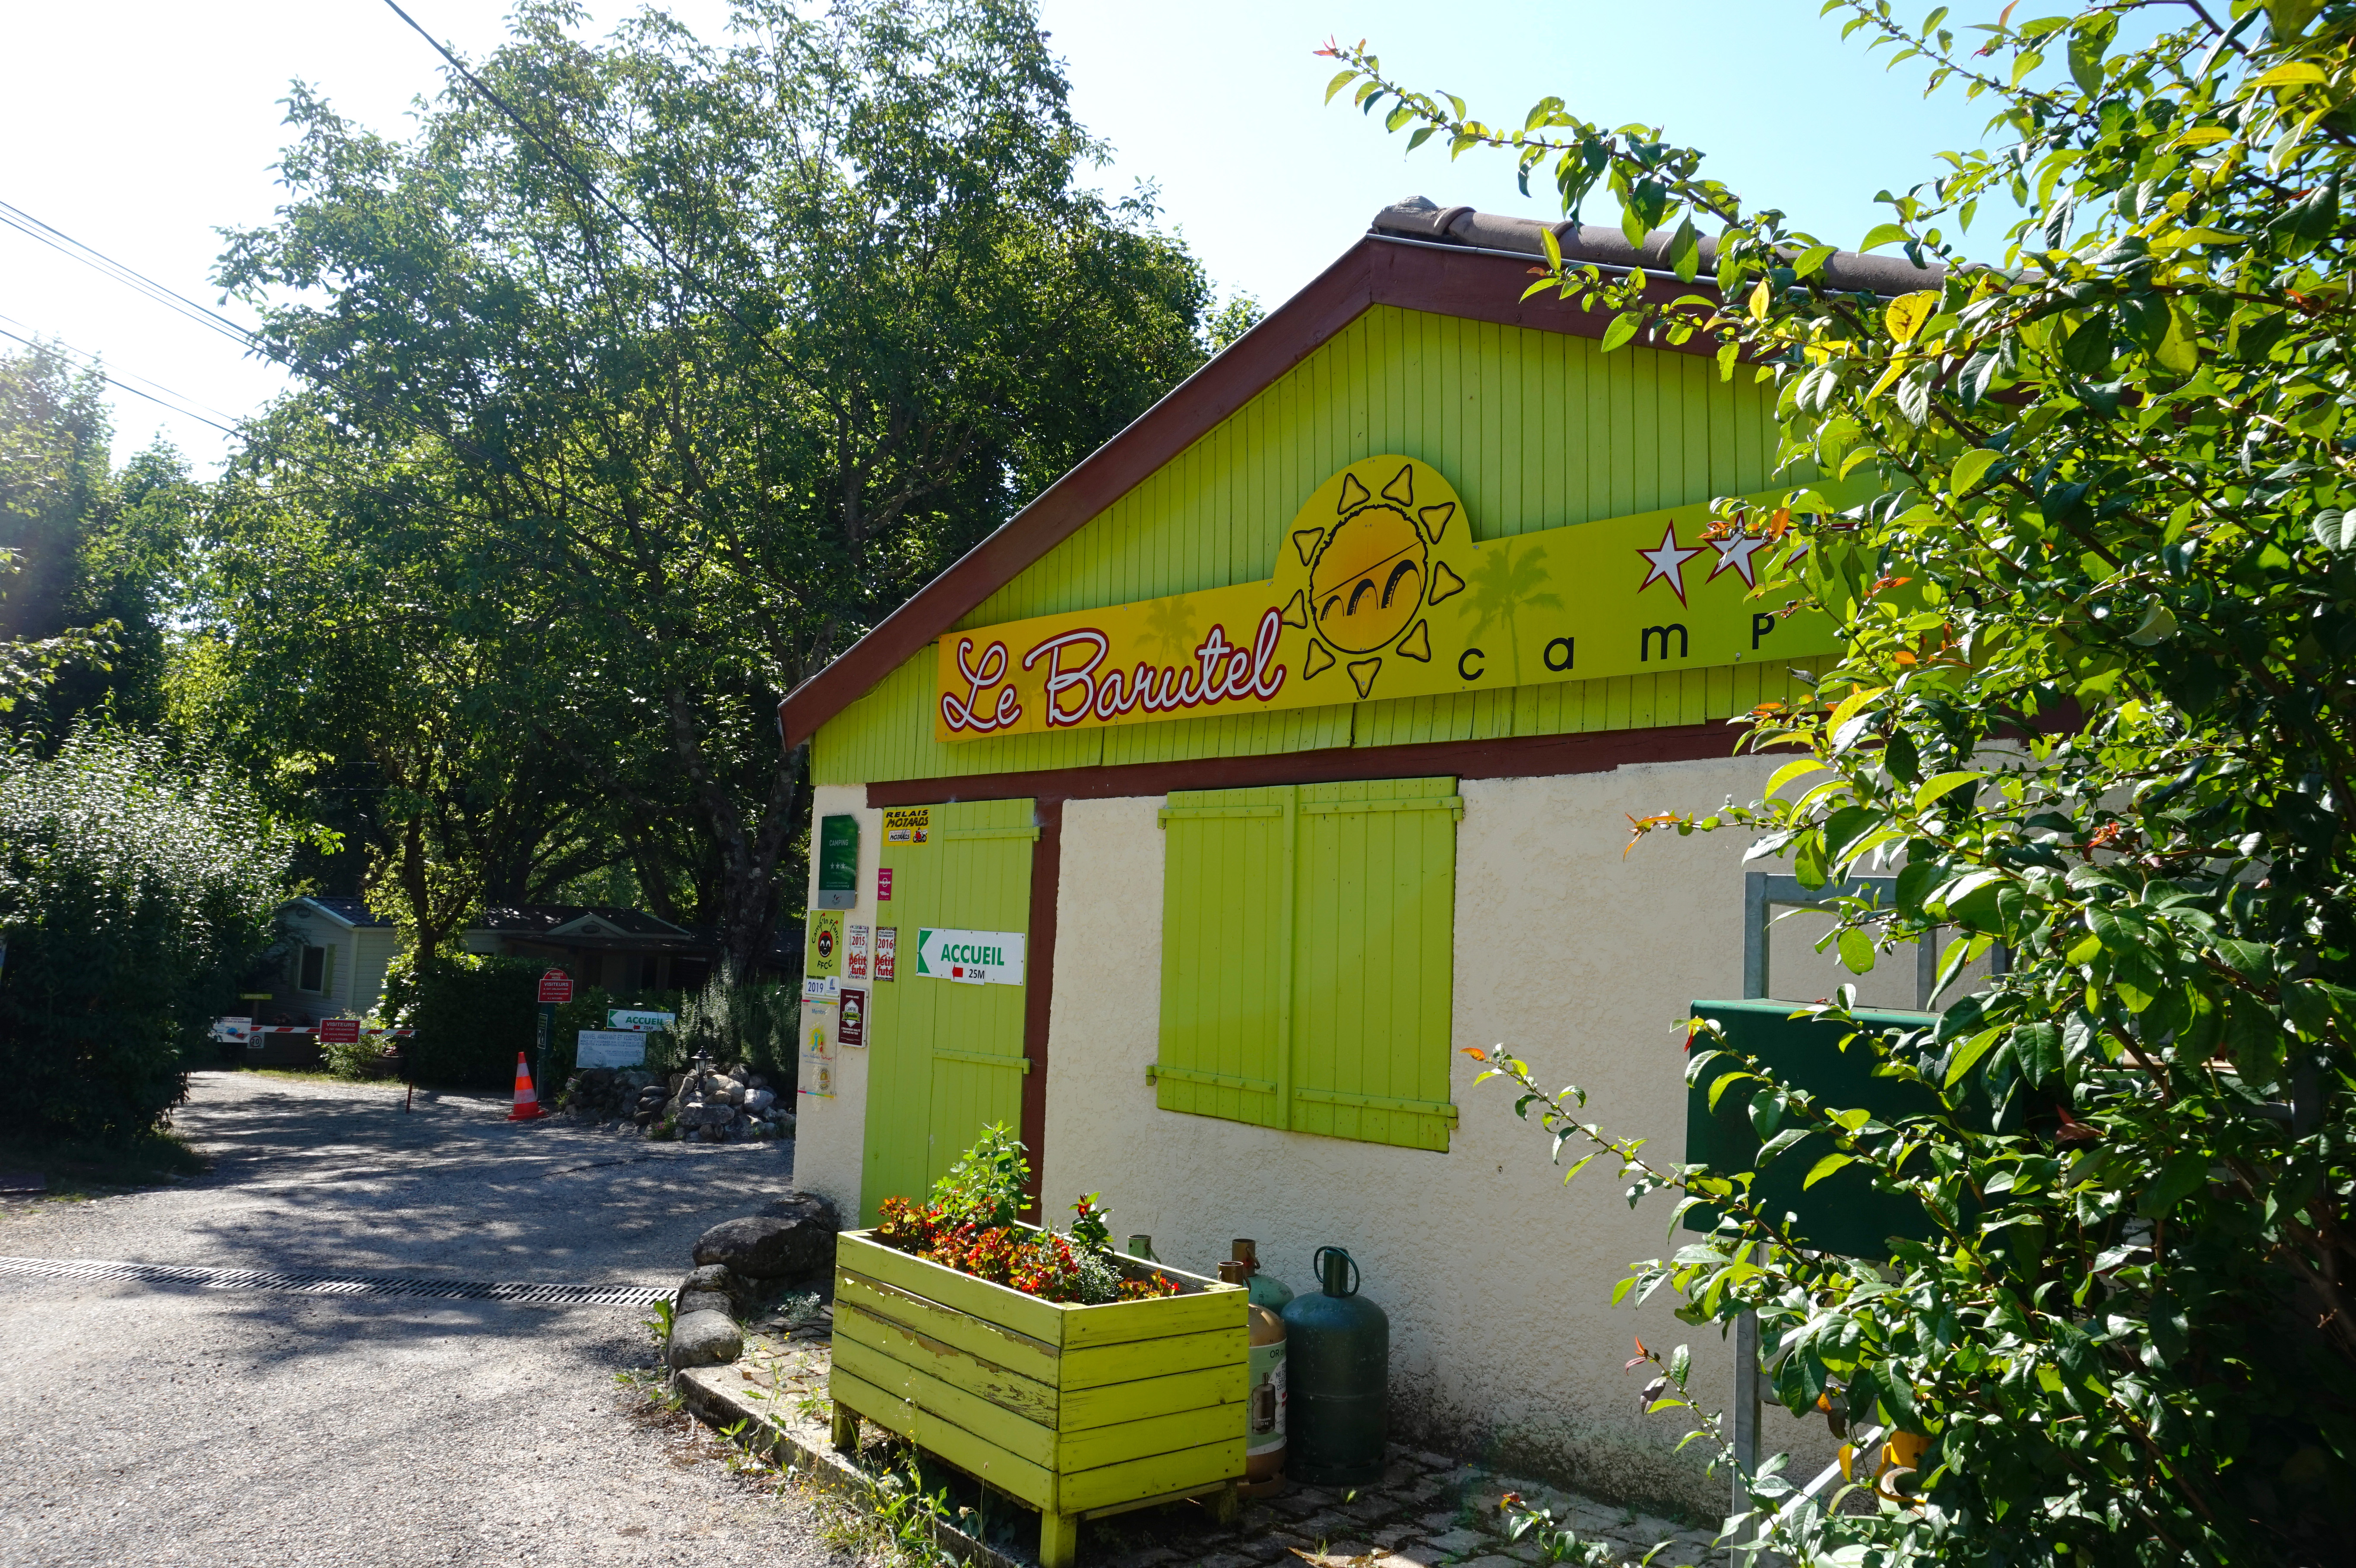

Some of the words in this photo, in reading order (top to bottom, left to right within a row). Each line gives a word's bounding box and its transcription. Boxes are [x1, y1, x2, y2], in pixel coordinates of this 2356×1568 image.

[941, 637, 1022, 733] Le
[1023, 606, 1287, 728] Barutel
[886, 809, 929, 818] RELAIS
[886, 816, 928, 828] MOTARDS
[852, 936, 865, 945] 2015
[878, 938, 893, 949] 2016
[940, 944, 1004, 966] ACCUEIL
[817, 959, 833, 970] FFCC
[849, 955, 867, 967] petit
[875, 956, 894, 967] petit
[851, 964, 866, 975] futé
[877, 965, 894, 977] futé
[969, 969, 985, 979] 25M
[808, 981, 823, 993] 2019
[625, 1016, 664, 1026] ACCUEIL
